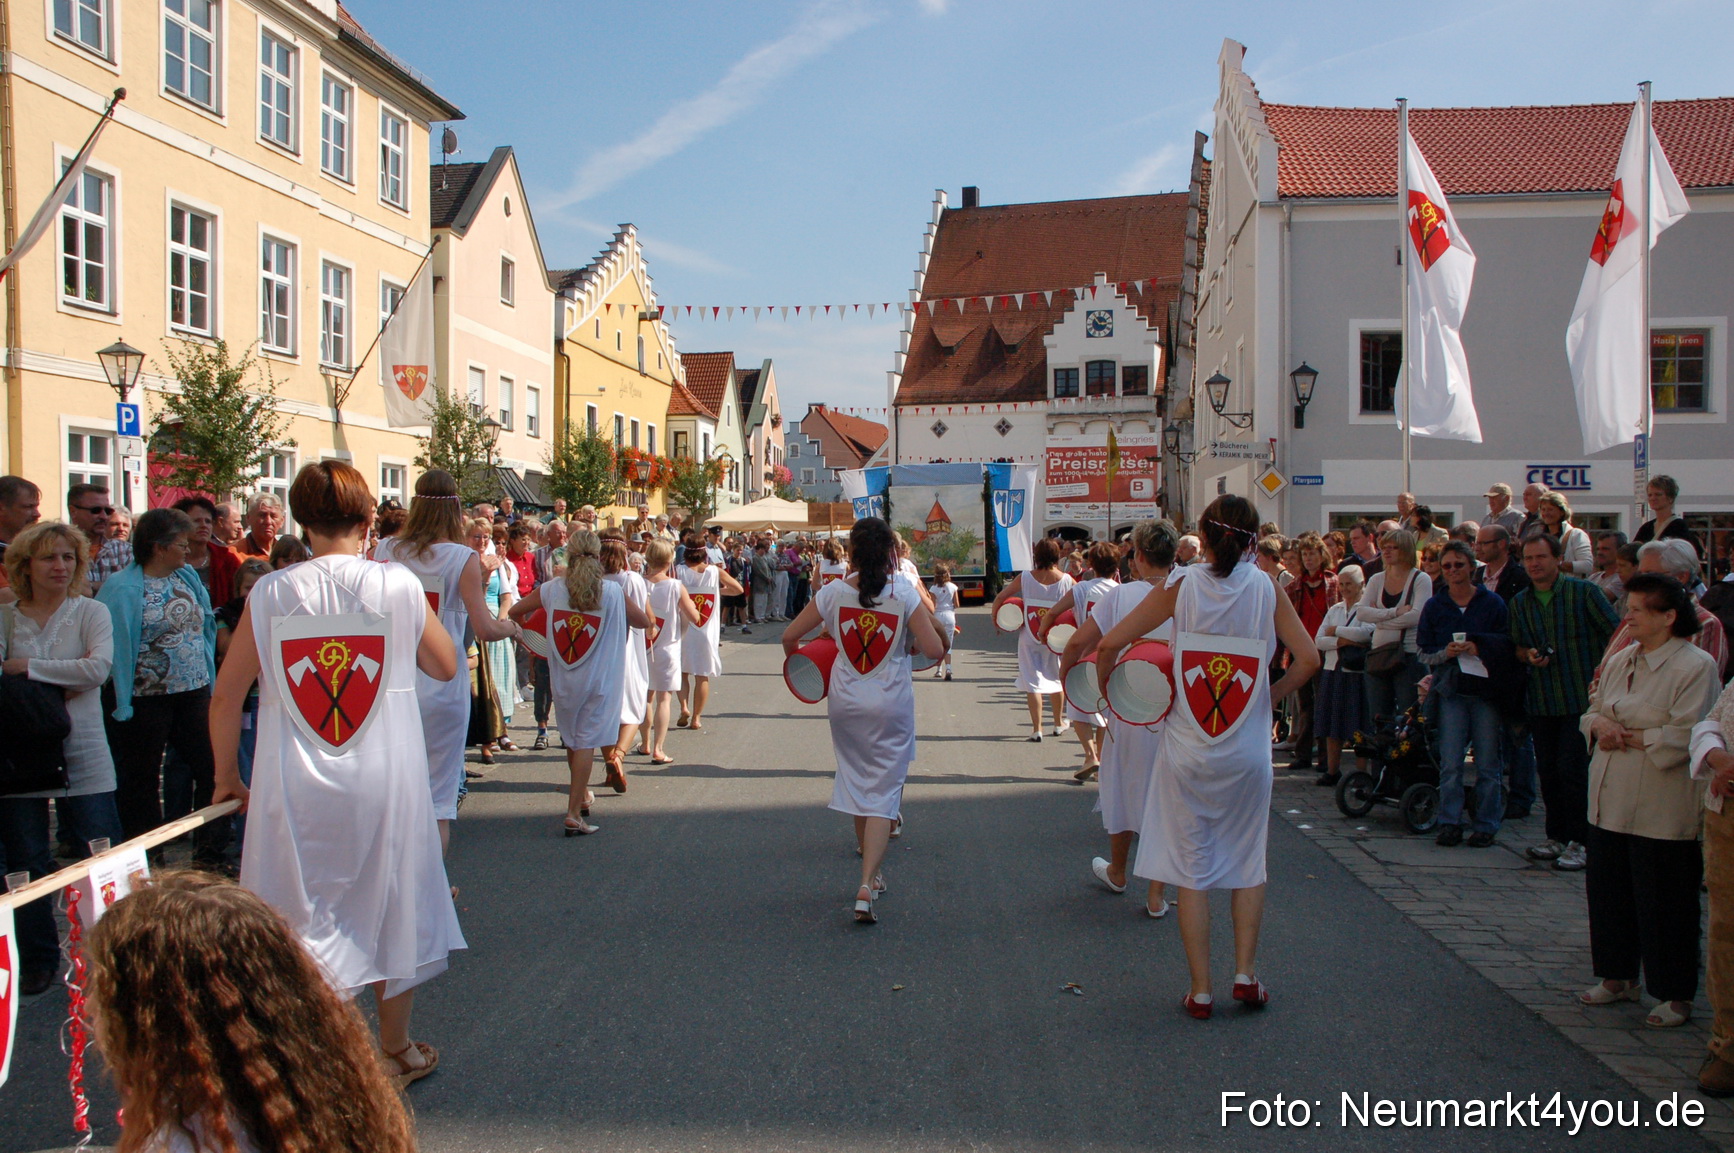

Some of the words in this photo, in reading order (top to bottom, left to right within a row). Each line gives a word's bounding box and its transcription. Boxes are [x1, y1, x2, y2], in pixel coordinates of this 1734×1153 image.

[122, 407, 134, 432] P
[1117, 436, 1154, 444] eilngries
[1636, 439, 1644, 464] P
[1050, 457, 1154, 469] Preisrtsel
[1294, 476, 1321, 485] Pfarrgasse
[1526, 469, 1591, 486] CECIL
[1133, 481, 1144, 491] B
